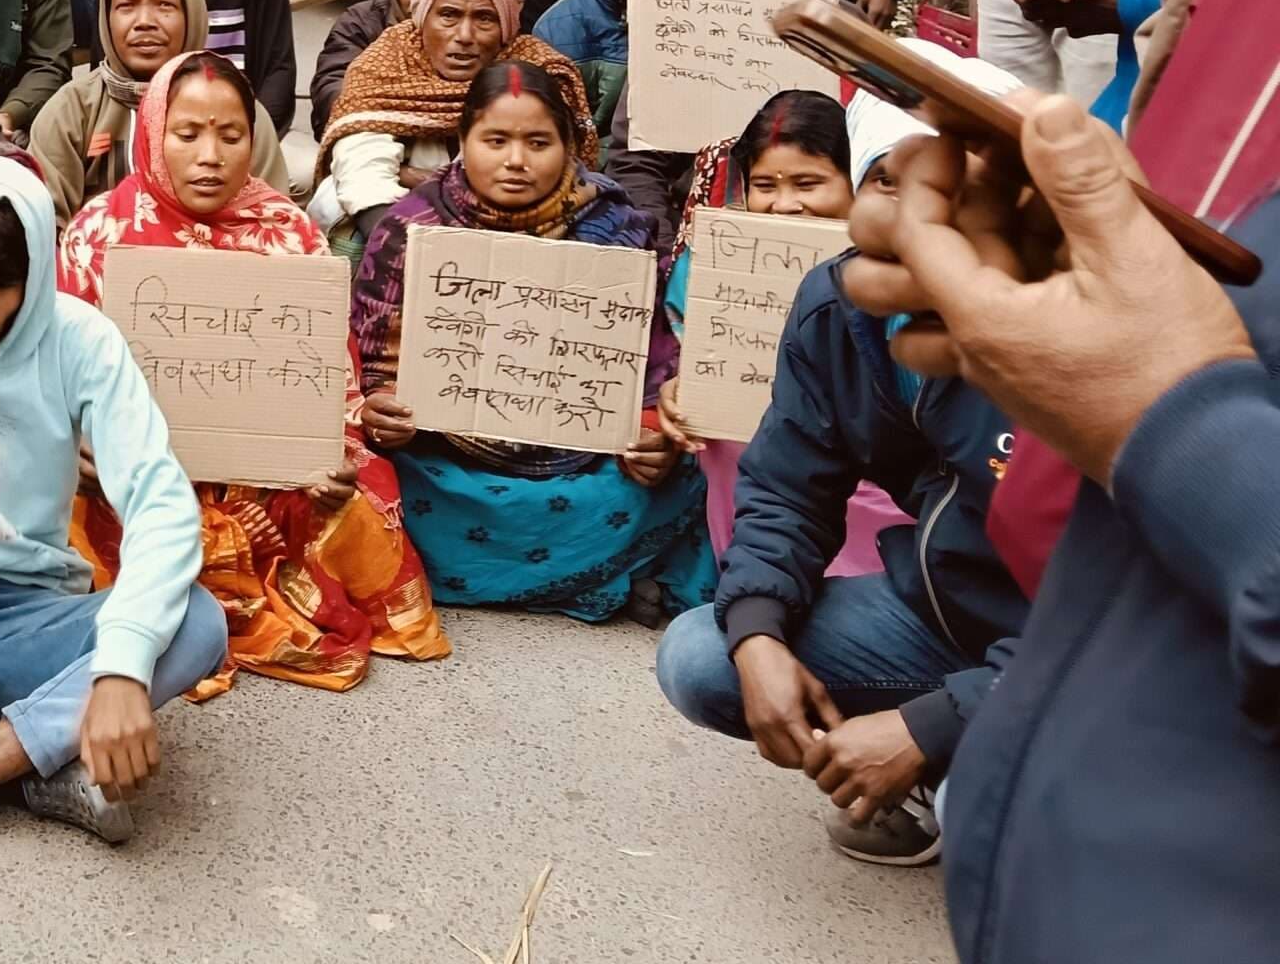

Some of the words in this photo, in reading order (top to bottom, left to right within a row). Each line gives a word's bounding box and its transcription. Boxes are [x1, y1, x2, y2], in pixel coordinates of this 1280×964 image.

[429, 261, 507, 305] जिला
[271, 304, 333, 337] का
[266, 339, 352, 398] करो
